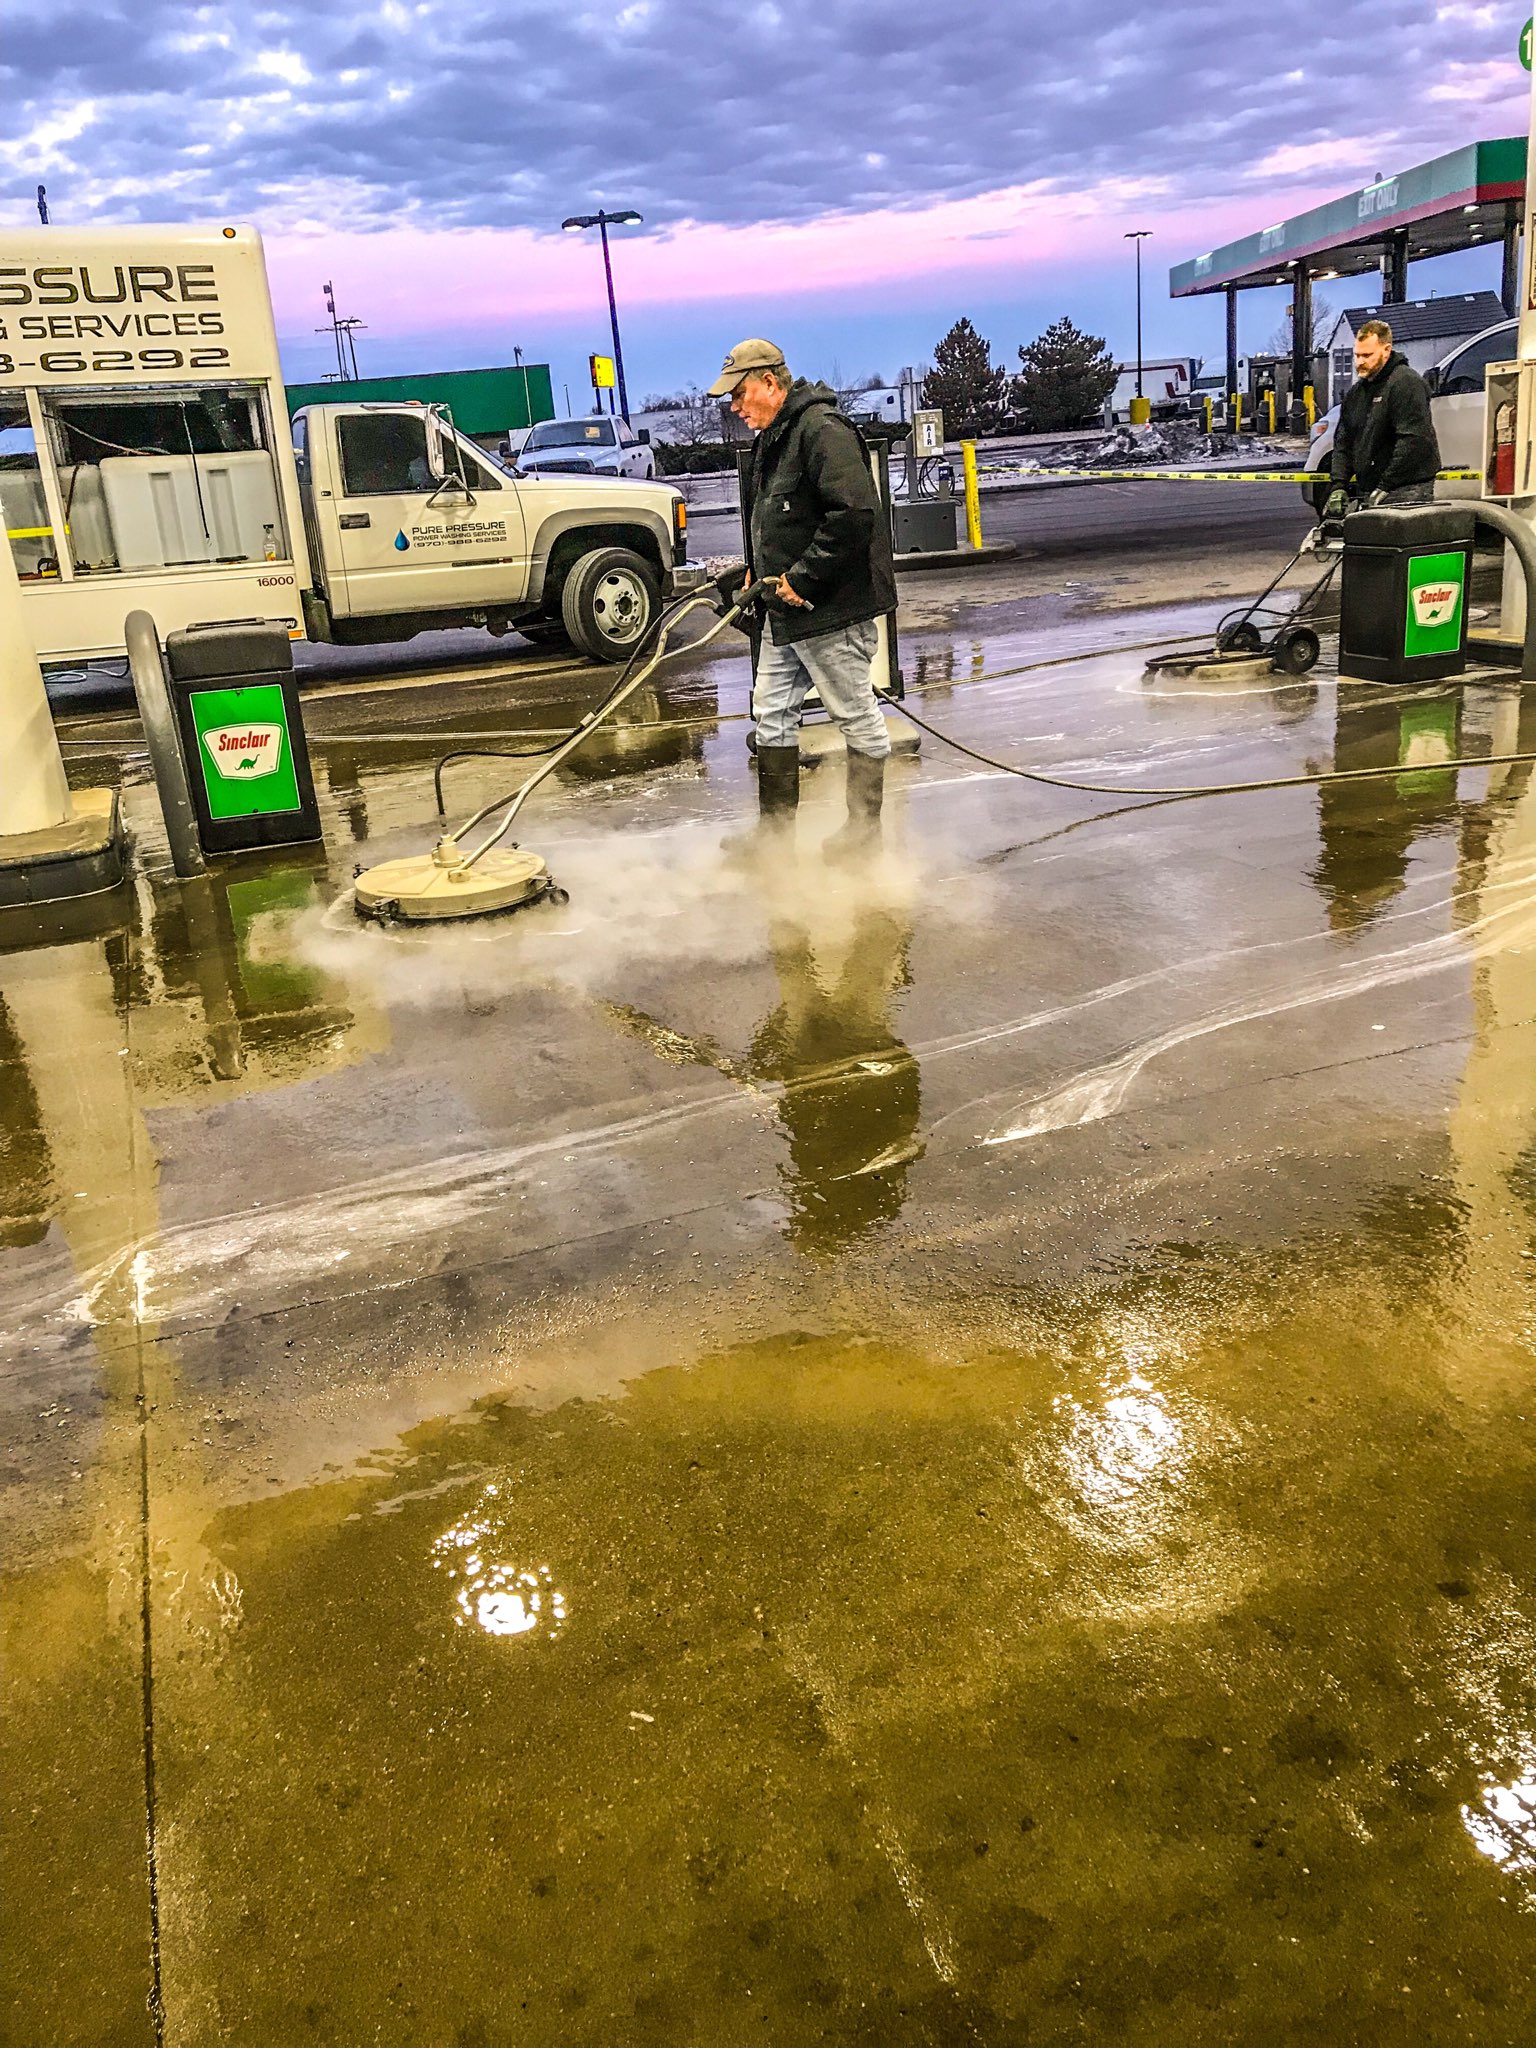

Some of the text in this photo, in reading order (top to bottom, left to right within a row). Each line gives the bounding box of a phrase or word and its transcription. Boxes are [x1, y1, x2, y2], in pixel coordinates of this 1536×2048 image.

[1377, 182, 1400, 211] ONLY
[0, 265, 219, 305] SSURE
[19, 312, 225, 340] SERVICES
[0, 347, 231, 374] -6292
[413, 521, 505, 535] PURE PRESSURE
[1419, 588, 1452, 604] Sinclair
[218, 731, 271, 752] Sinclair
